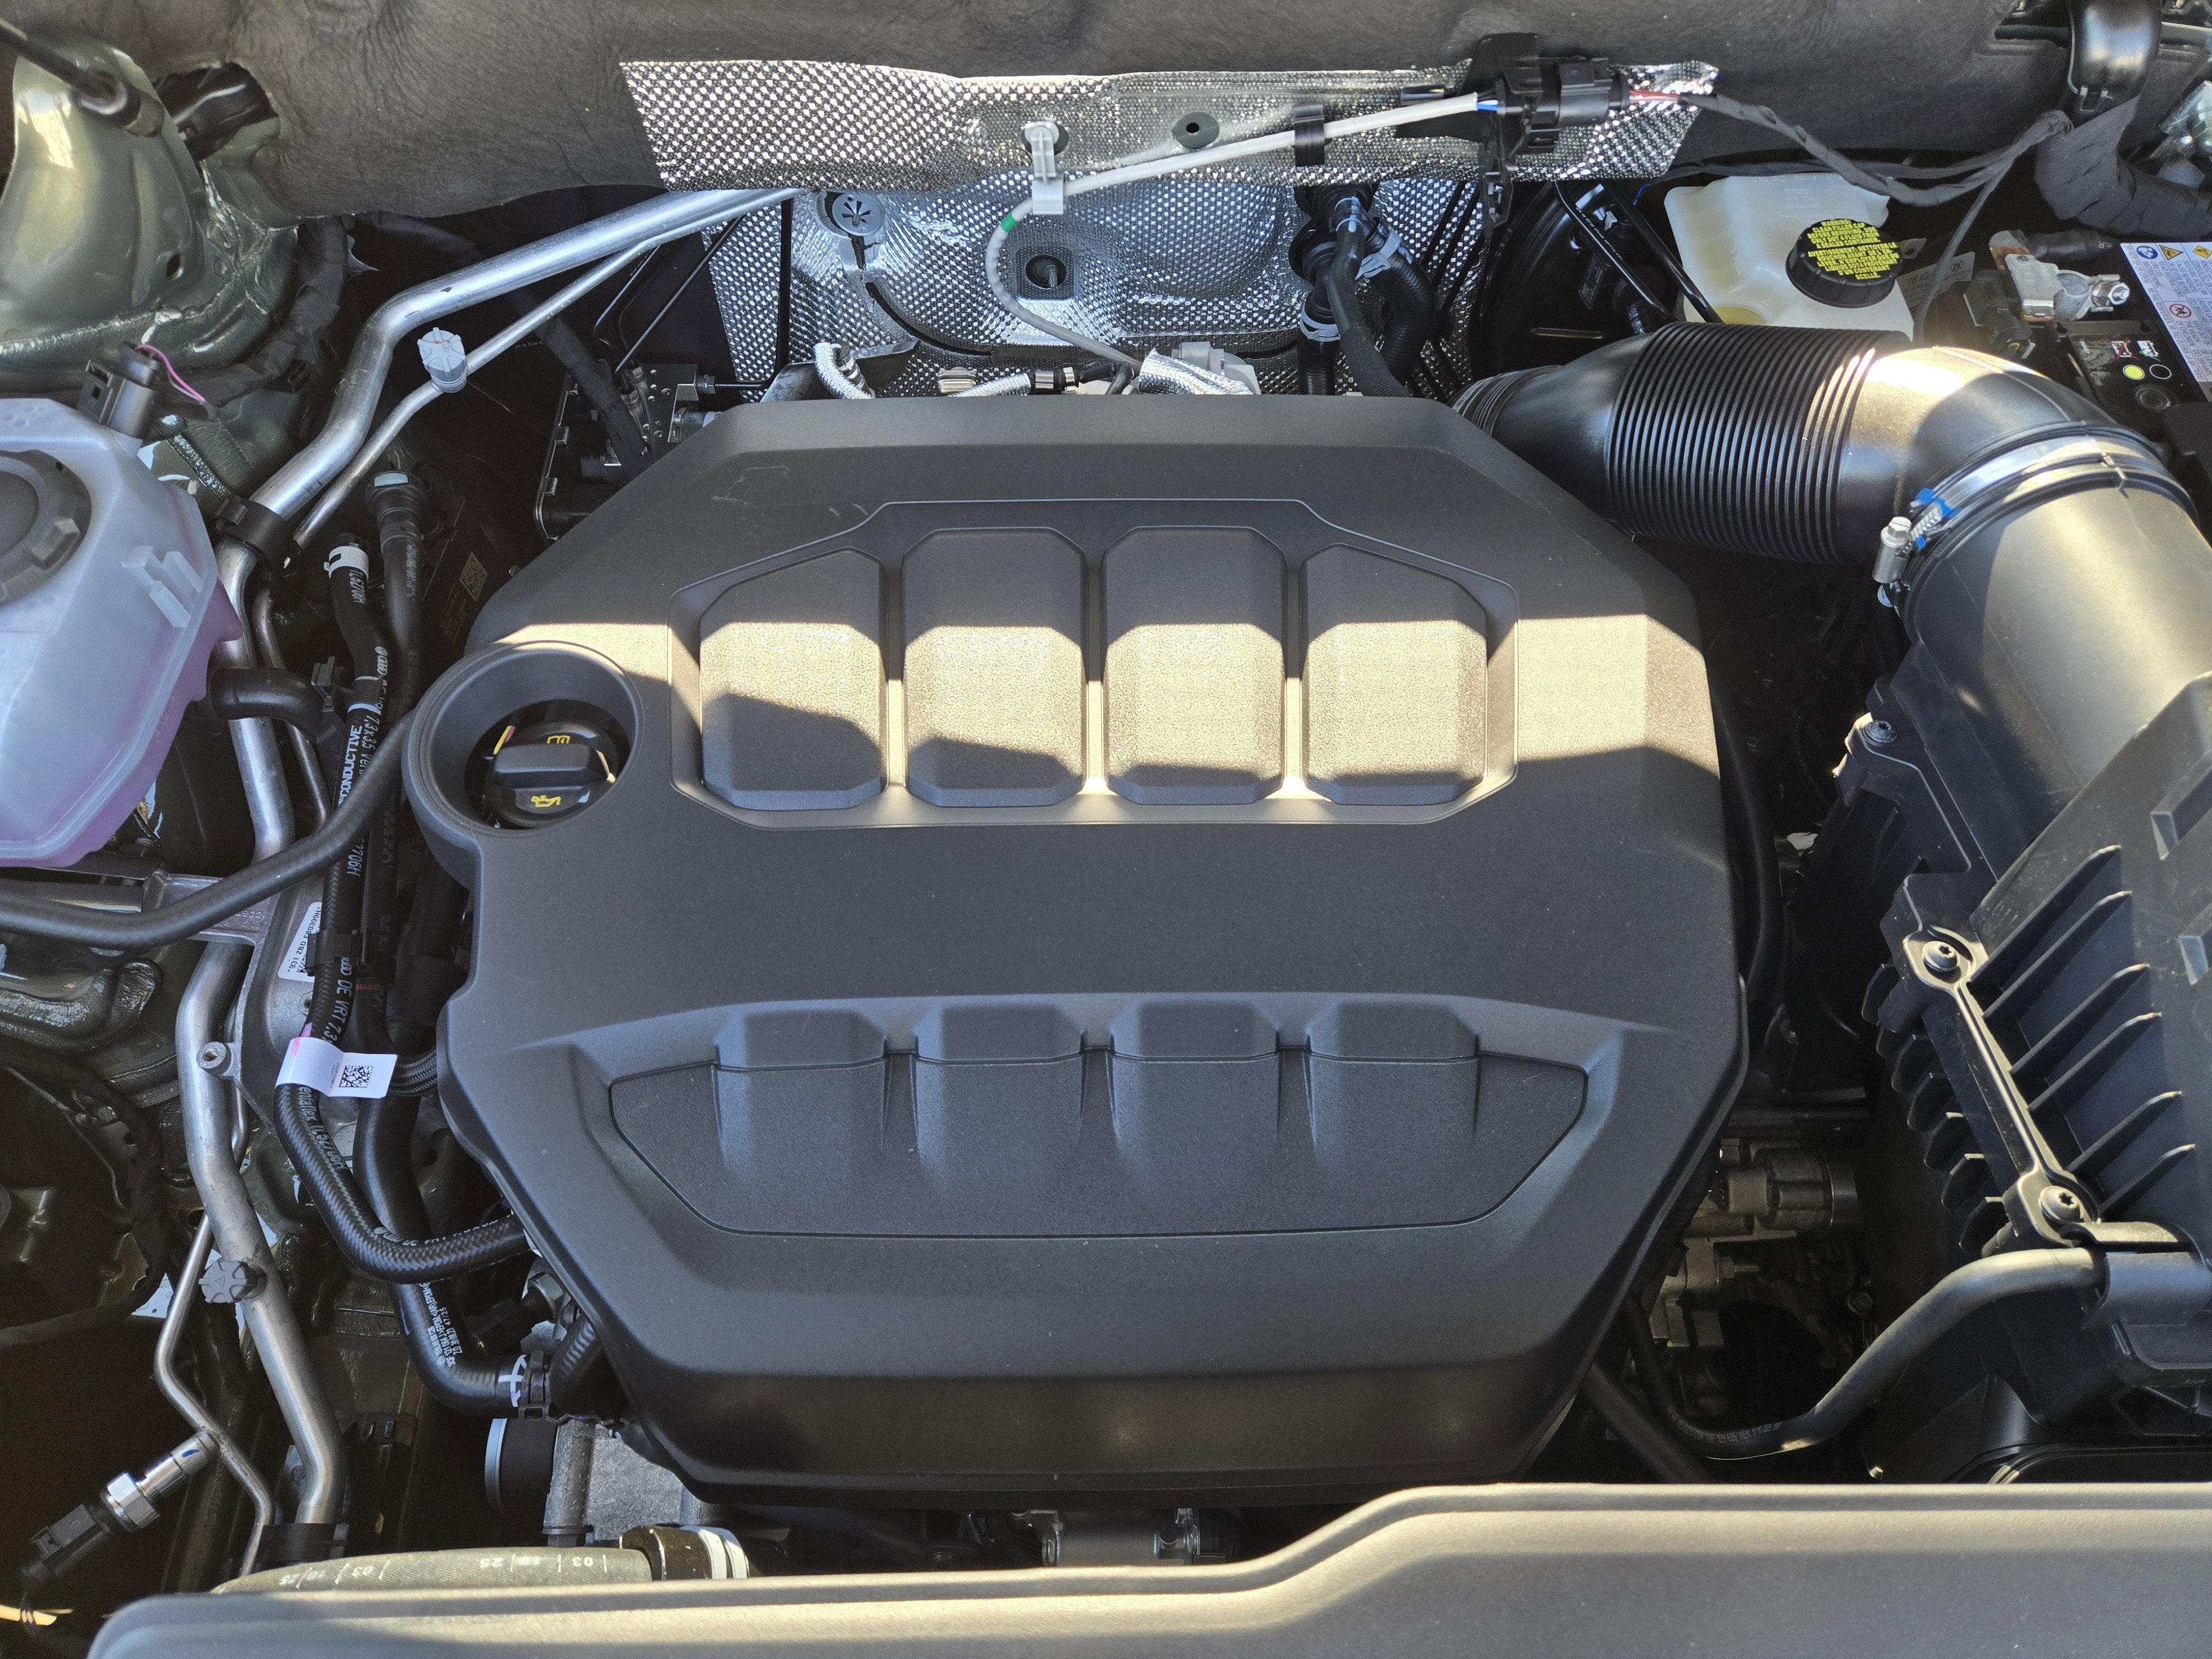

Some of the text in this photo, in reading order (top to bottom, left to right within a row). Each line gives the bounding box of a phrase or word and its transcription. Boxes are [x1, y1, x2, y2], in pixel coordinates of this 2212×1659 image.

[1807, 231, 1831, 239] BEFORE
[1847, 251, 1867, 259] AVANT
[341, 724, 362, 797] CONDUCTIVE
[337, 979, 352, 997] DE
[330, 999, 350, 1023] VRT
